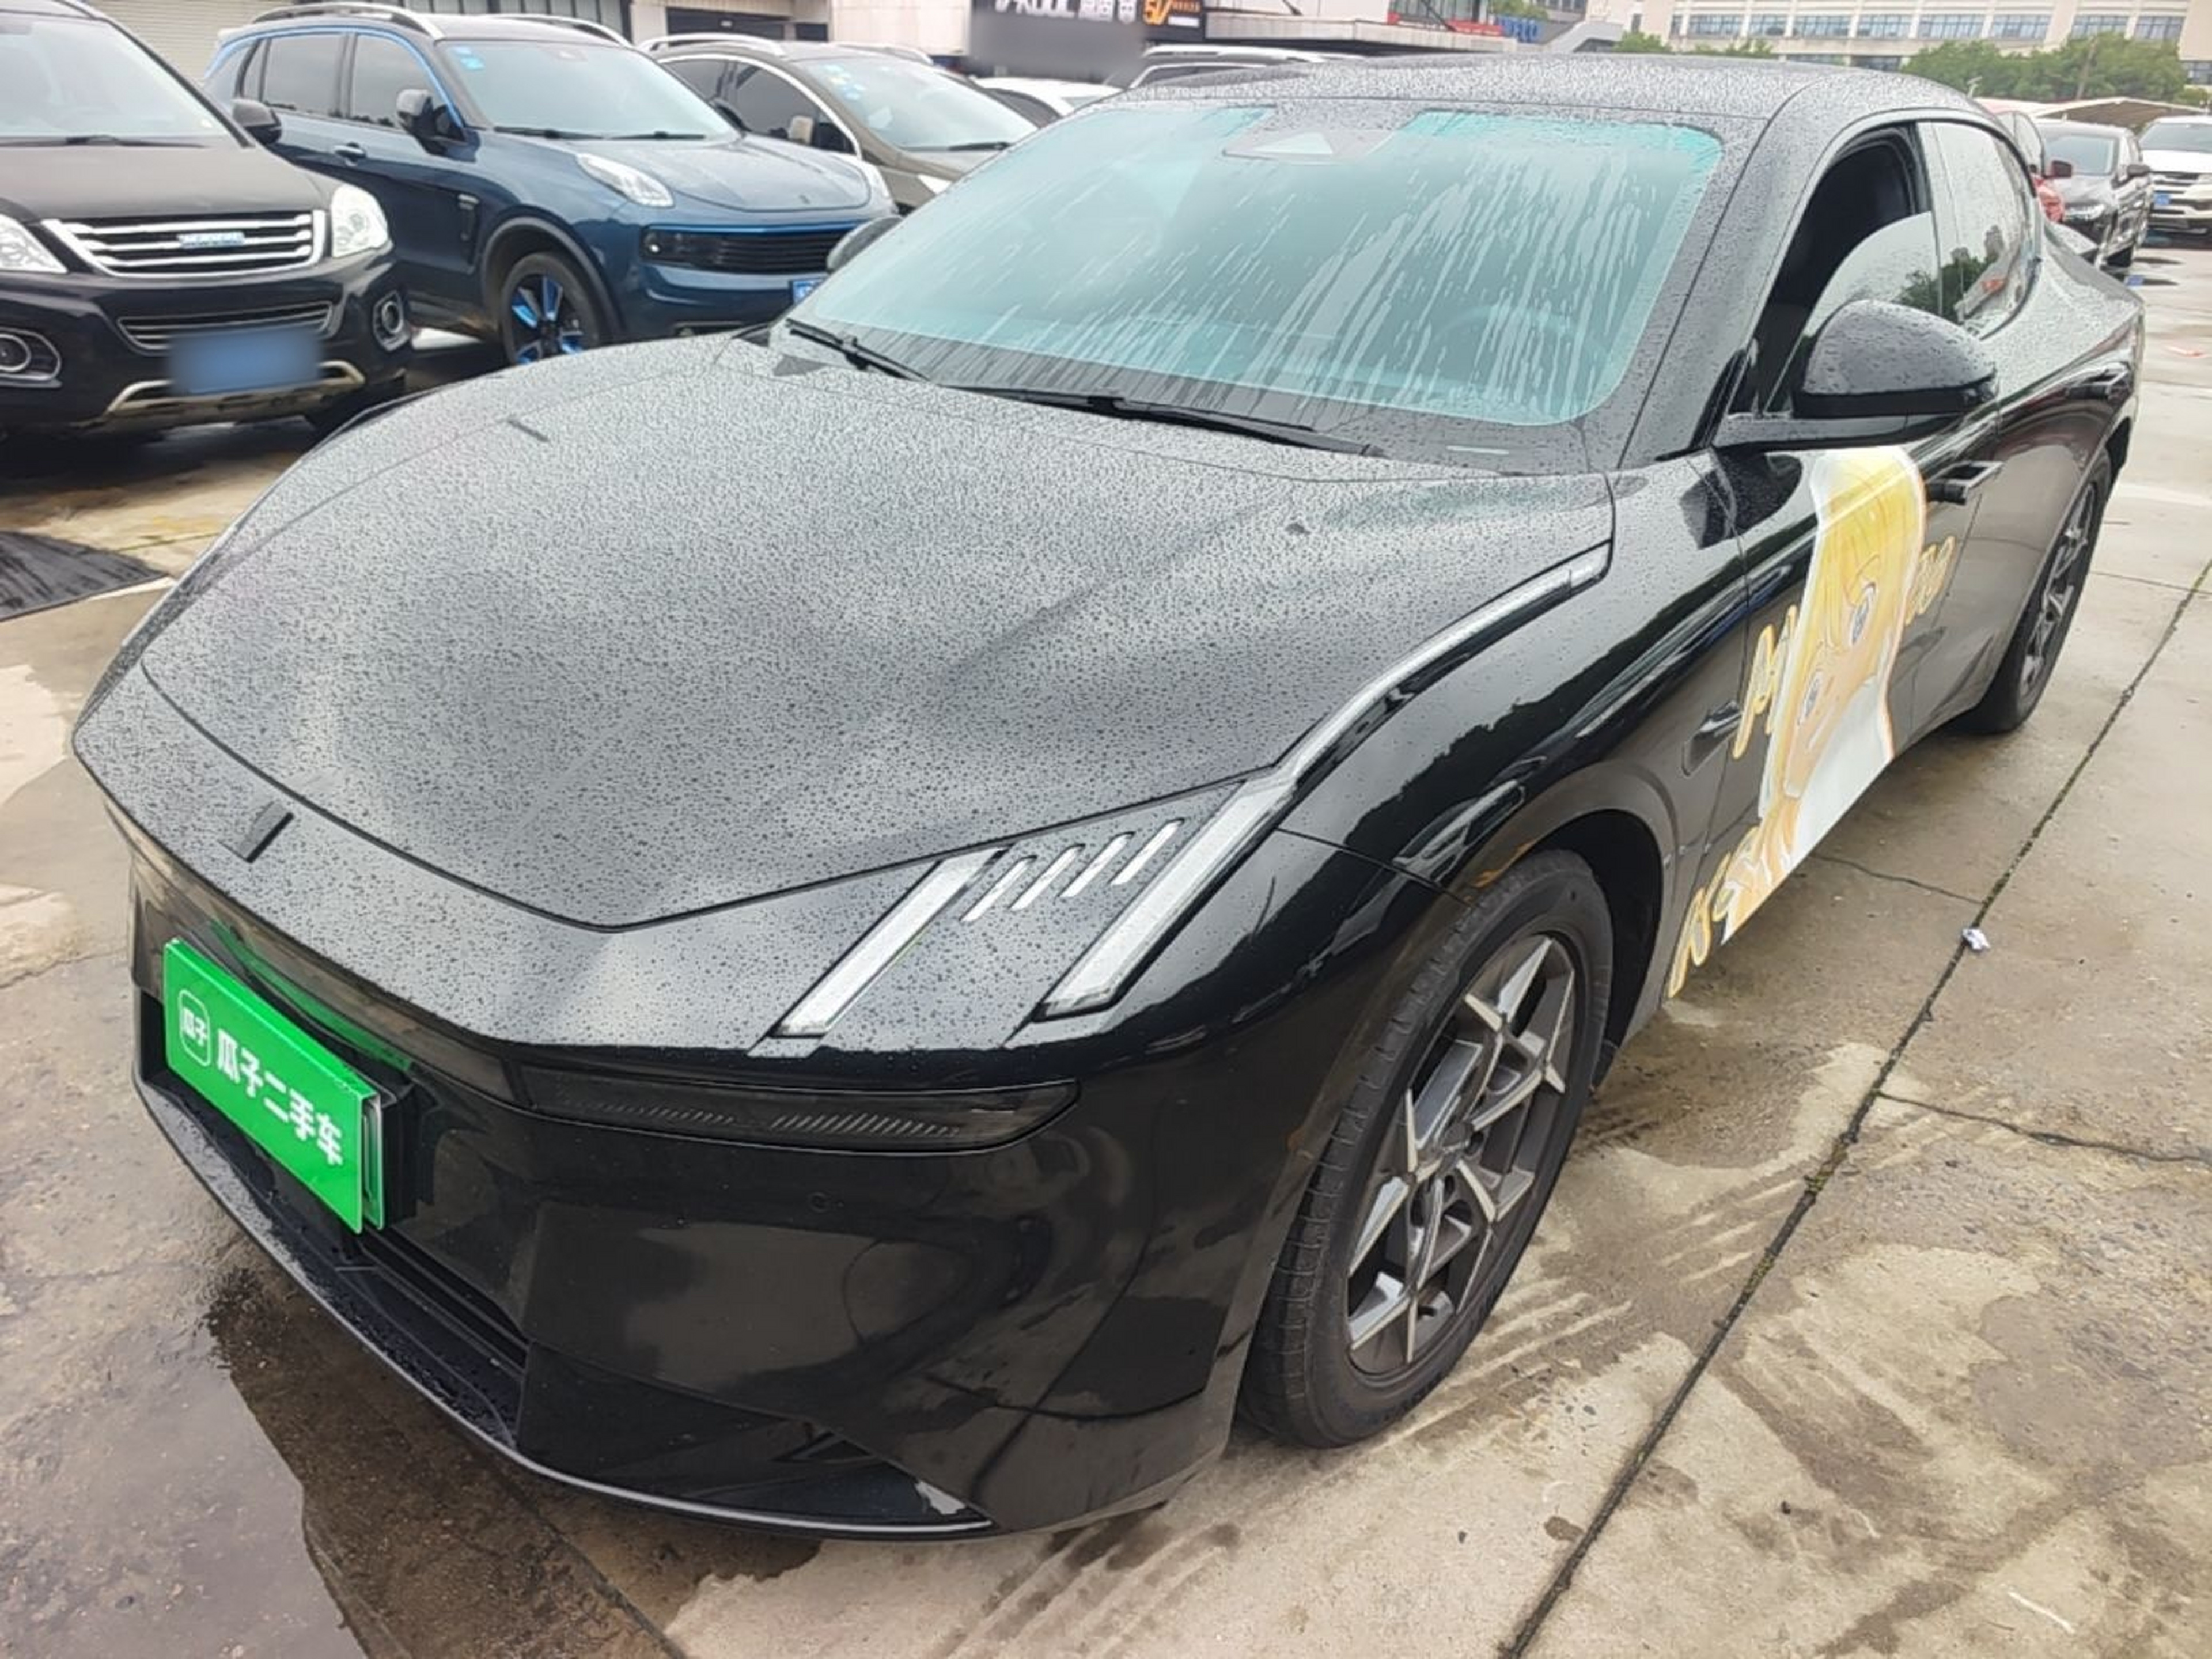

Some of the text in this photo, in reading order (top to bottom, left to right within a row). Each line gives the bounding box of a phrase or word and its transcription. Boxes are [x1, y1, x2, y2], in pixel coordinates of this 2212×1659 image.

[181, 1007, 208, 1046] 瓜子
[216, 1028, 343, 1166] 瓜子二手车
